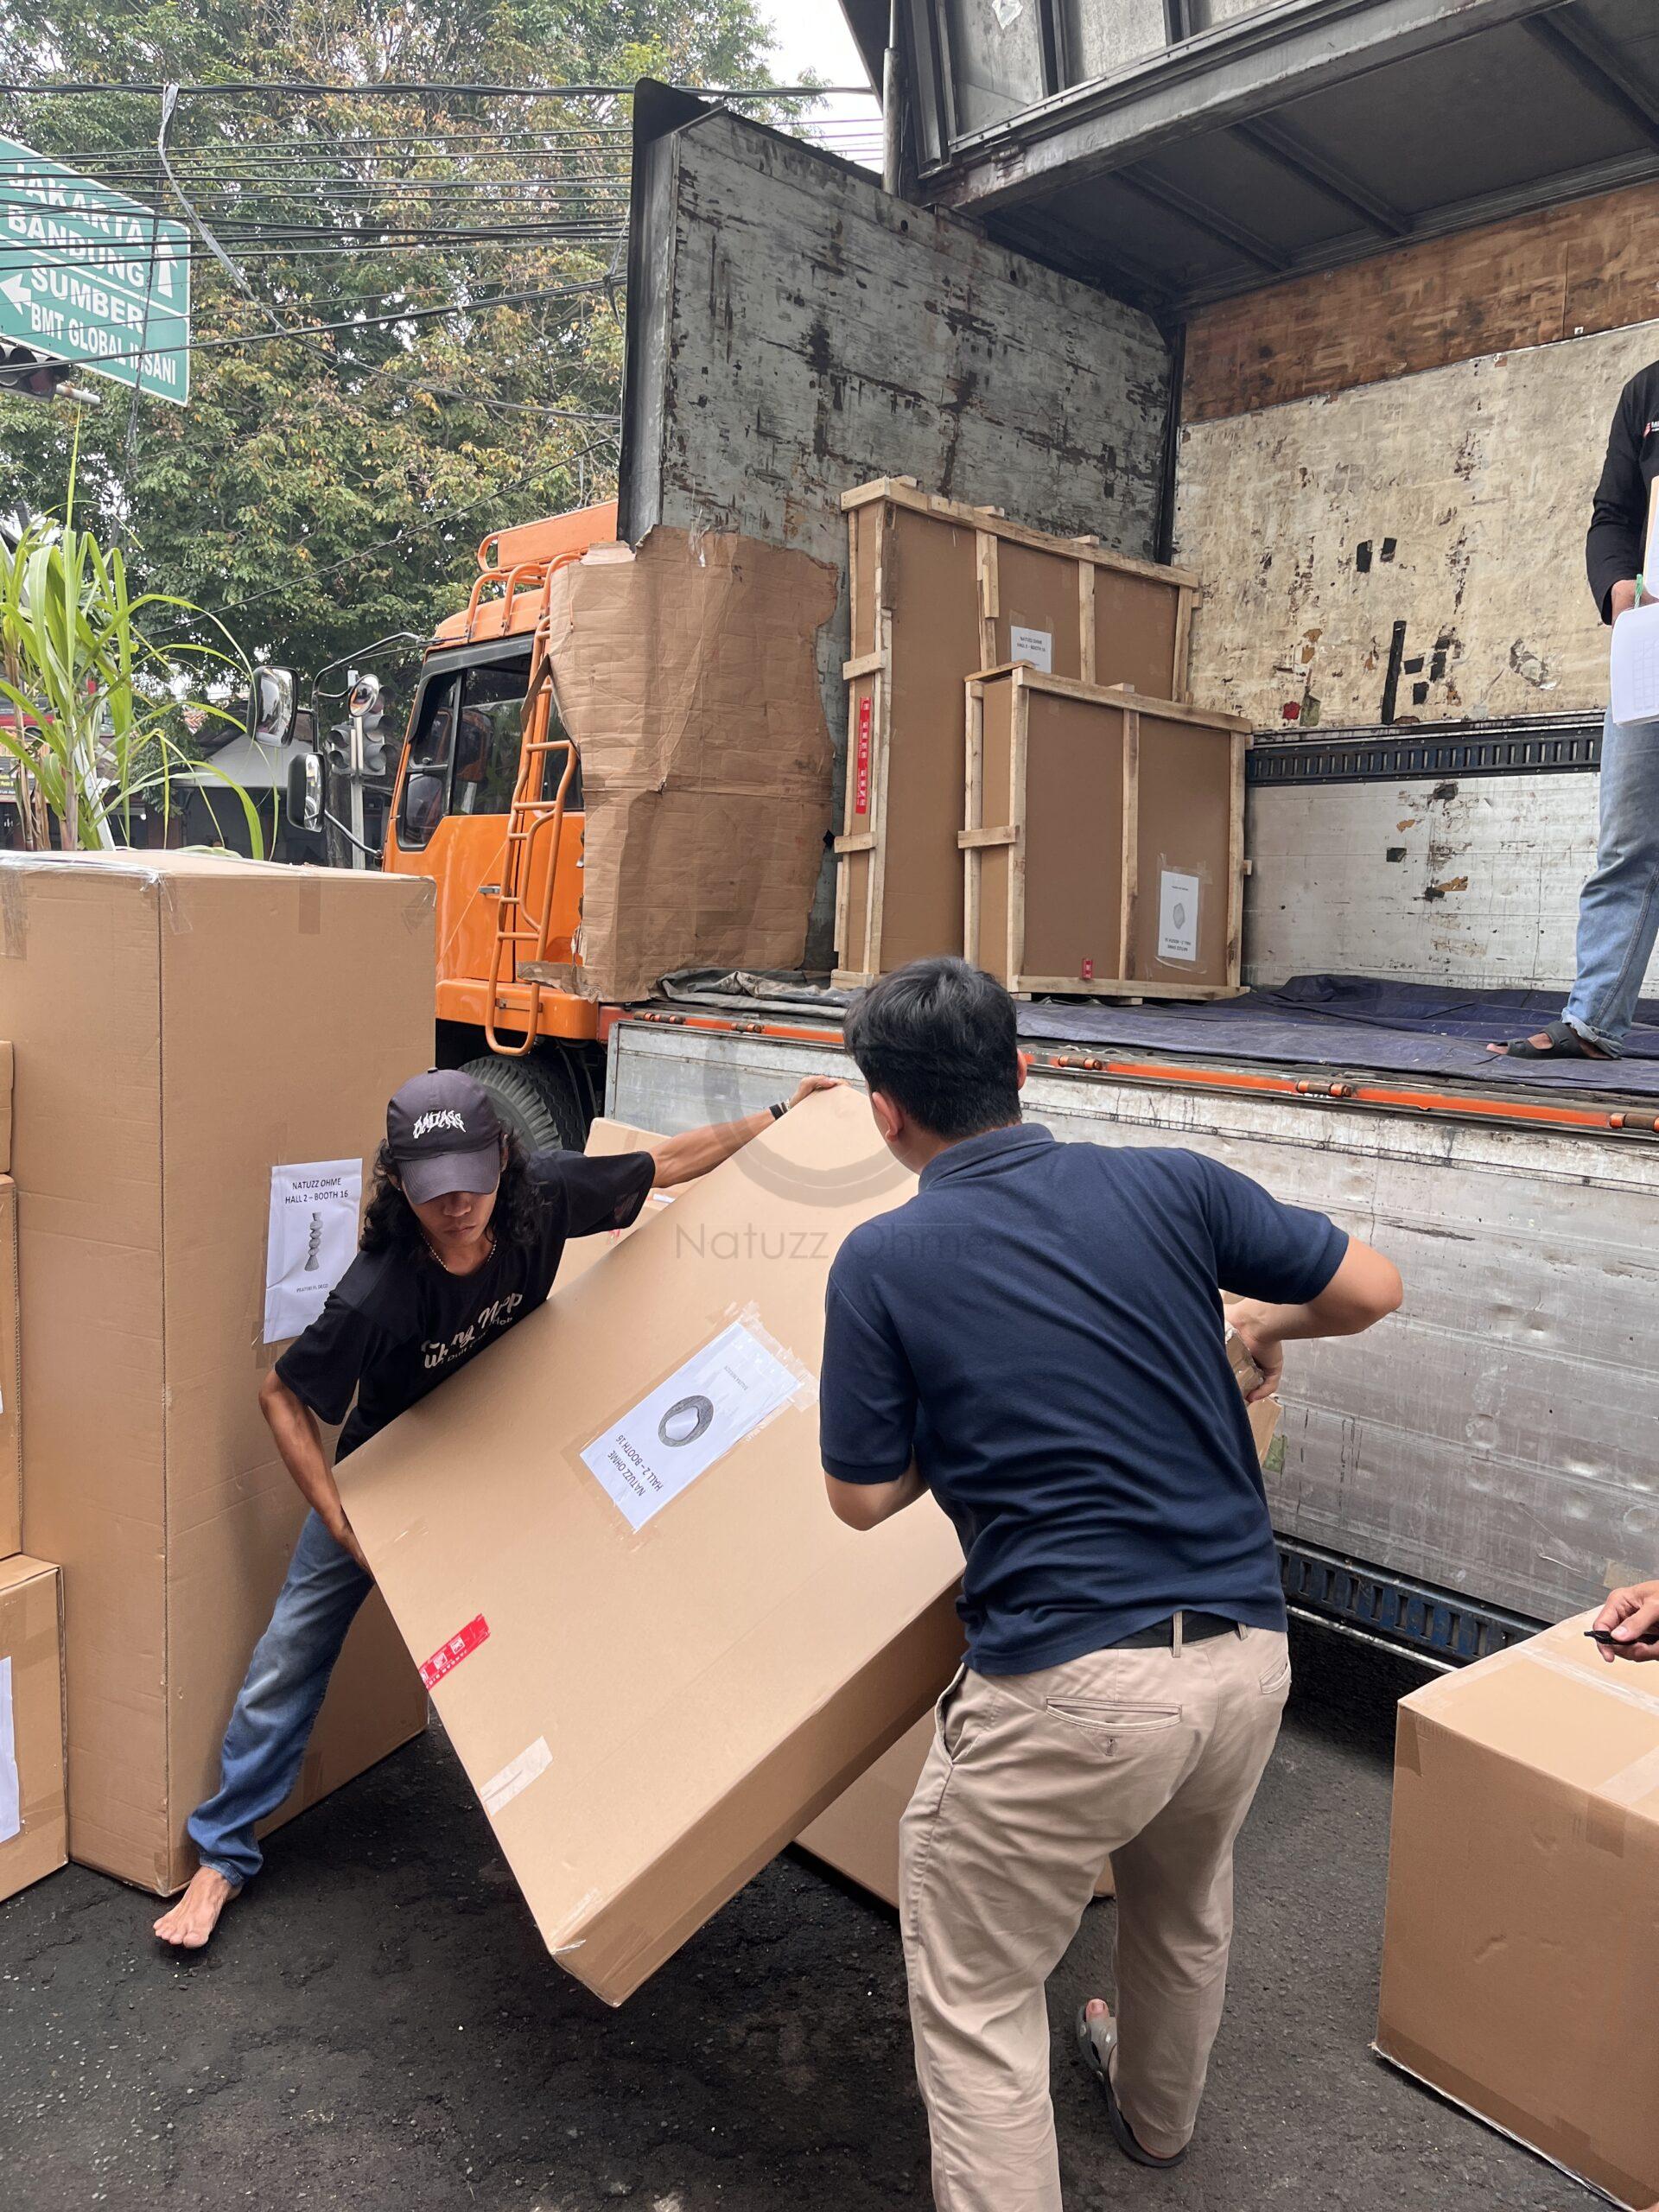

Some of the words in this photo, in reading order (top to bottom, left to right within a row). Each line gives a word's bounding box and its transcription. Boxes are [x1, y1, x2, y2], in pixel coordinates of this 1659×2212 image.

[9, 162, 145, 251] JAKARTA
[8, 204, 144, 287] BANDUNG
[31, 266, 144, 334] SUMBER
[31, 302, 65, 341] BMT
[68, 320, 126, 365] GLOBAL
[292, 1180, 320, 1190] NATUZZ
[321, 1178, 341, 1187] OHME
[285, 1194, 302, 1205] HALL
[315, 1192, 338, 1201] BOOTH
[340, 1190, 348, 1198] 16
[615, 1434, 626, 1445] 16
[607, 1450, 626, 1471] OHME
[621, 1440, 643, 1466] BOOTH
[642, 1466, 651, 1475] 2
[646, 1471, 664, 1491] HALL
[621, 1468, 646, 1497] NATUZZ
